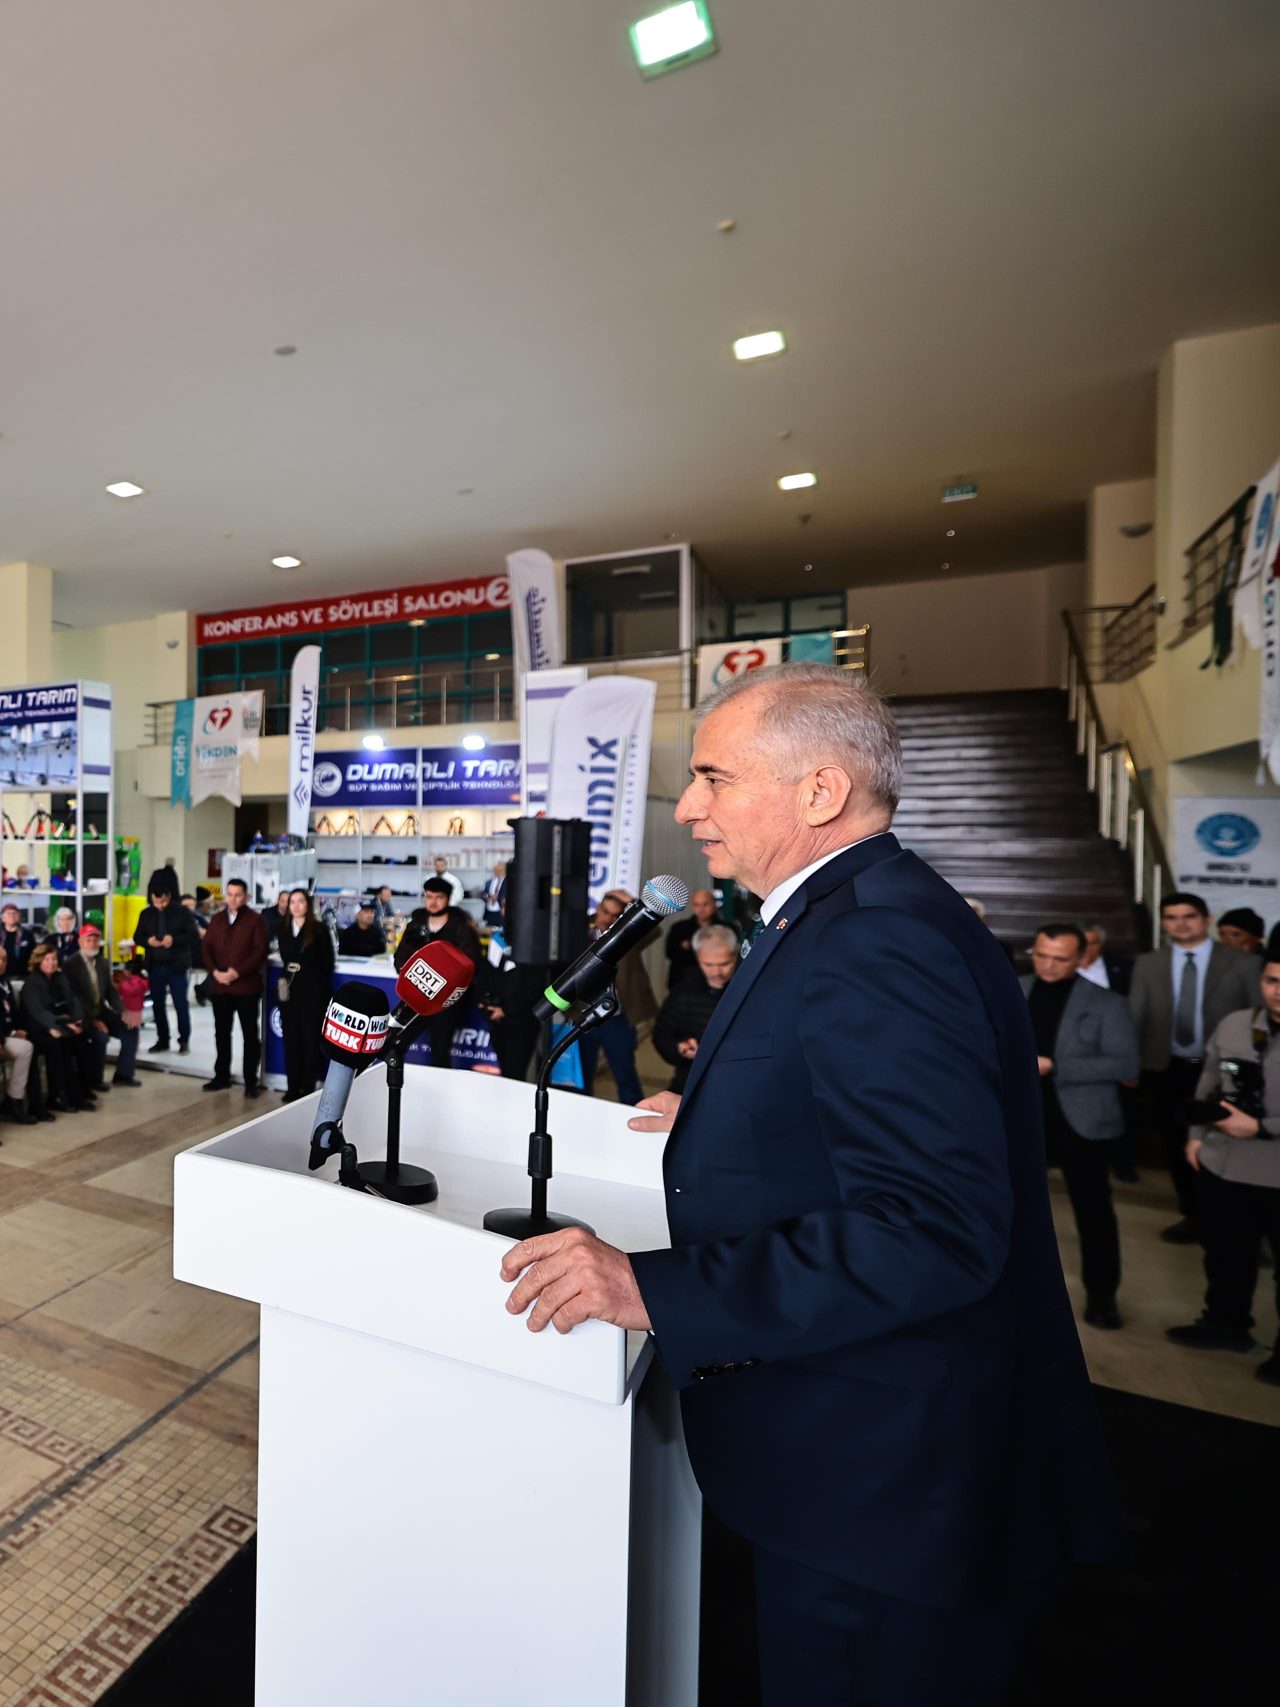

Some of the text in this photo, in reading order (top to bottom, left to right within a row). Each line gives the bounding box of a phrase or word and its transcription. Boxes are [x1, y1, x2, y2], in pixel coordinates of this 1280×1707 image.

[203, 610, 298, 637] KONFERANS
[301, 607, 323, 624] VE
[329, 592, 398, 621] SÖYLEŞİ
[404, 586, 485, 613] SALONU
[26, 688, 77, 706] TARIM
[295, 684, 314, 773] milkur
[346, 759, 520, 781] DUMANLI TAR
[415, 965, 440, 987] DRT
[331, 1007, 366, 1030] WORLD
[326, 1023, 361, 1050] TURK
